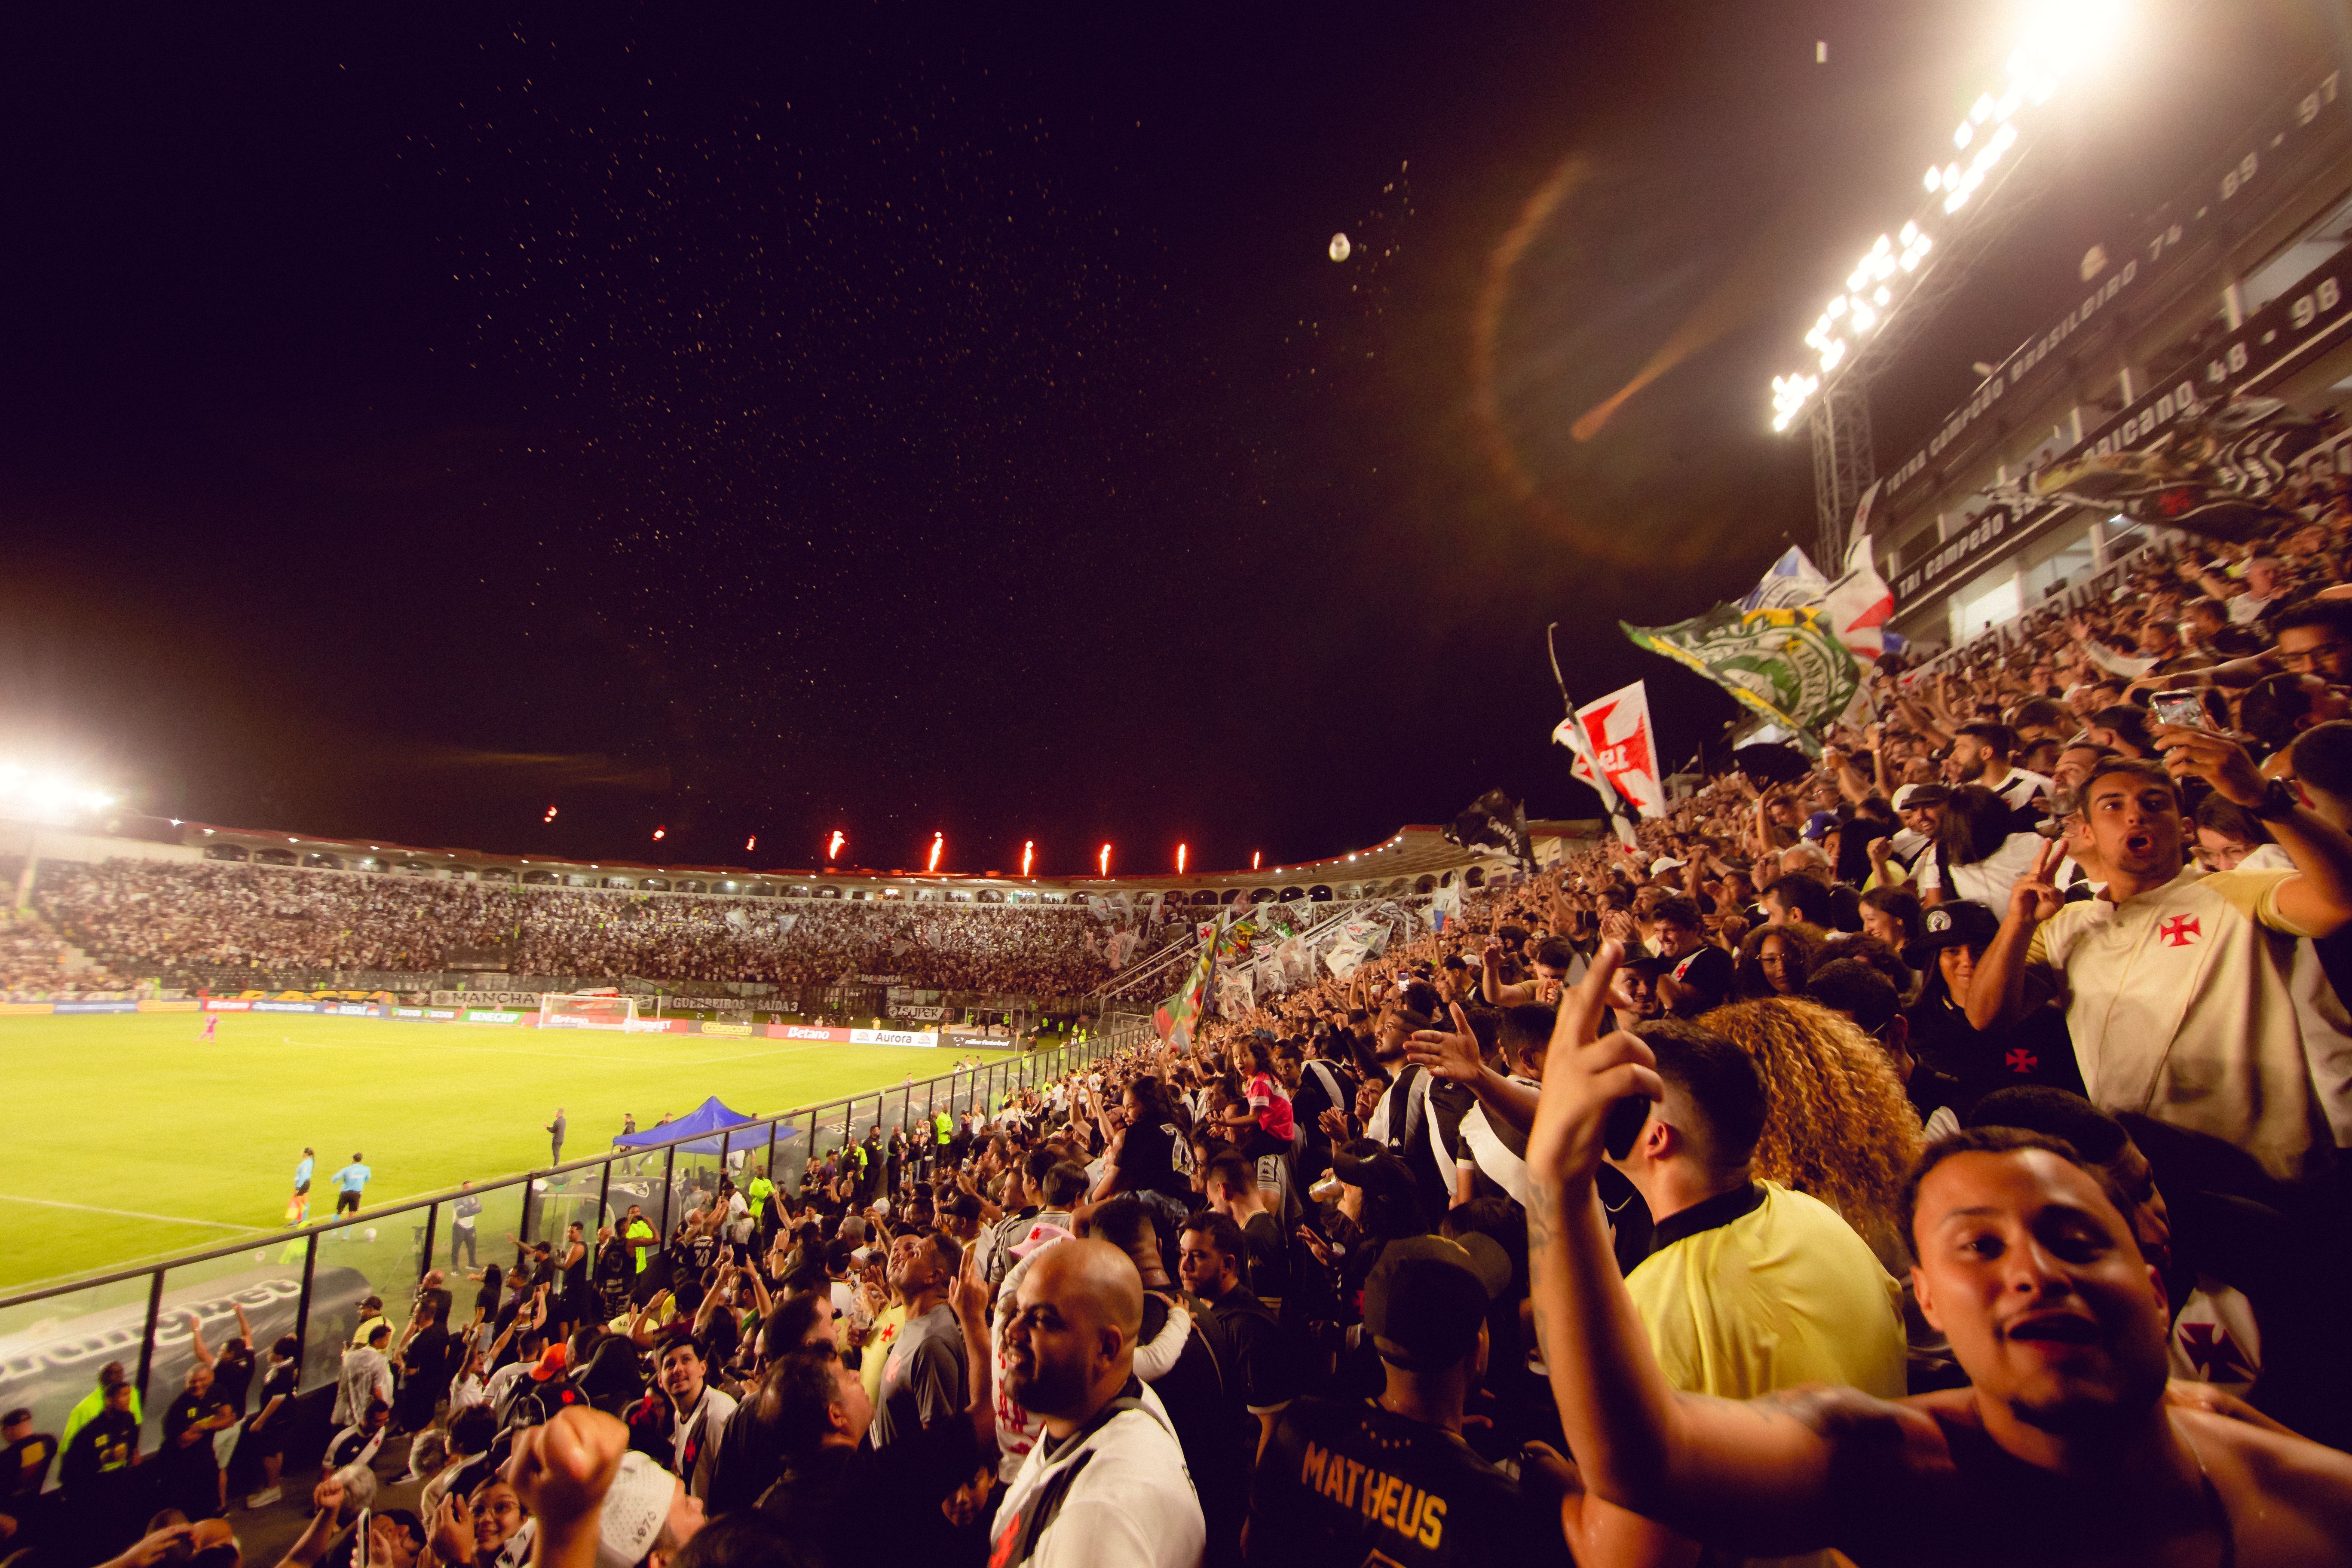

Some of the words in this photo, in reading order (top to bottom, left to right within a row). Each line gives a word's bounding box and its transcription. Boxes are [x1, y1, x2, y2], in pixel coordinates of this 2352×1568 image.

[2291, 277, 2341, 330] 98
[453, 992, 535, 1004] MANCHA
[673, 998, 746, 1009] GUERREIROS
[791, 1001, 798, 1011] 3
[903, 1007, 938, 1018] SUPER
[787, 1027, 830, 1040] Betano
[876, 1033, 913, 1043] Aurora
[1302, 1440, 1448, 1551] MATHEUS
[632, 1511, 656, 1544] 1970
